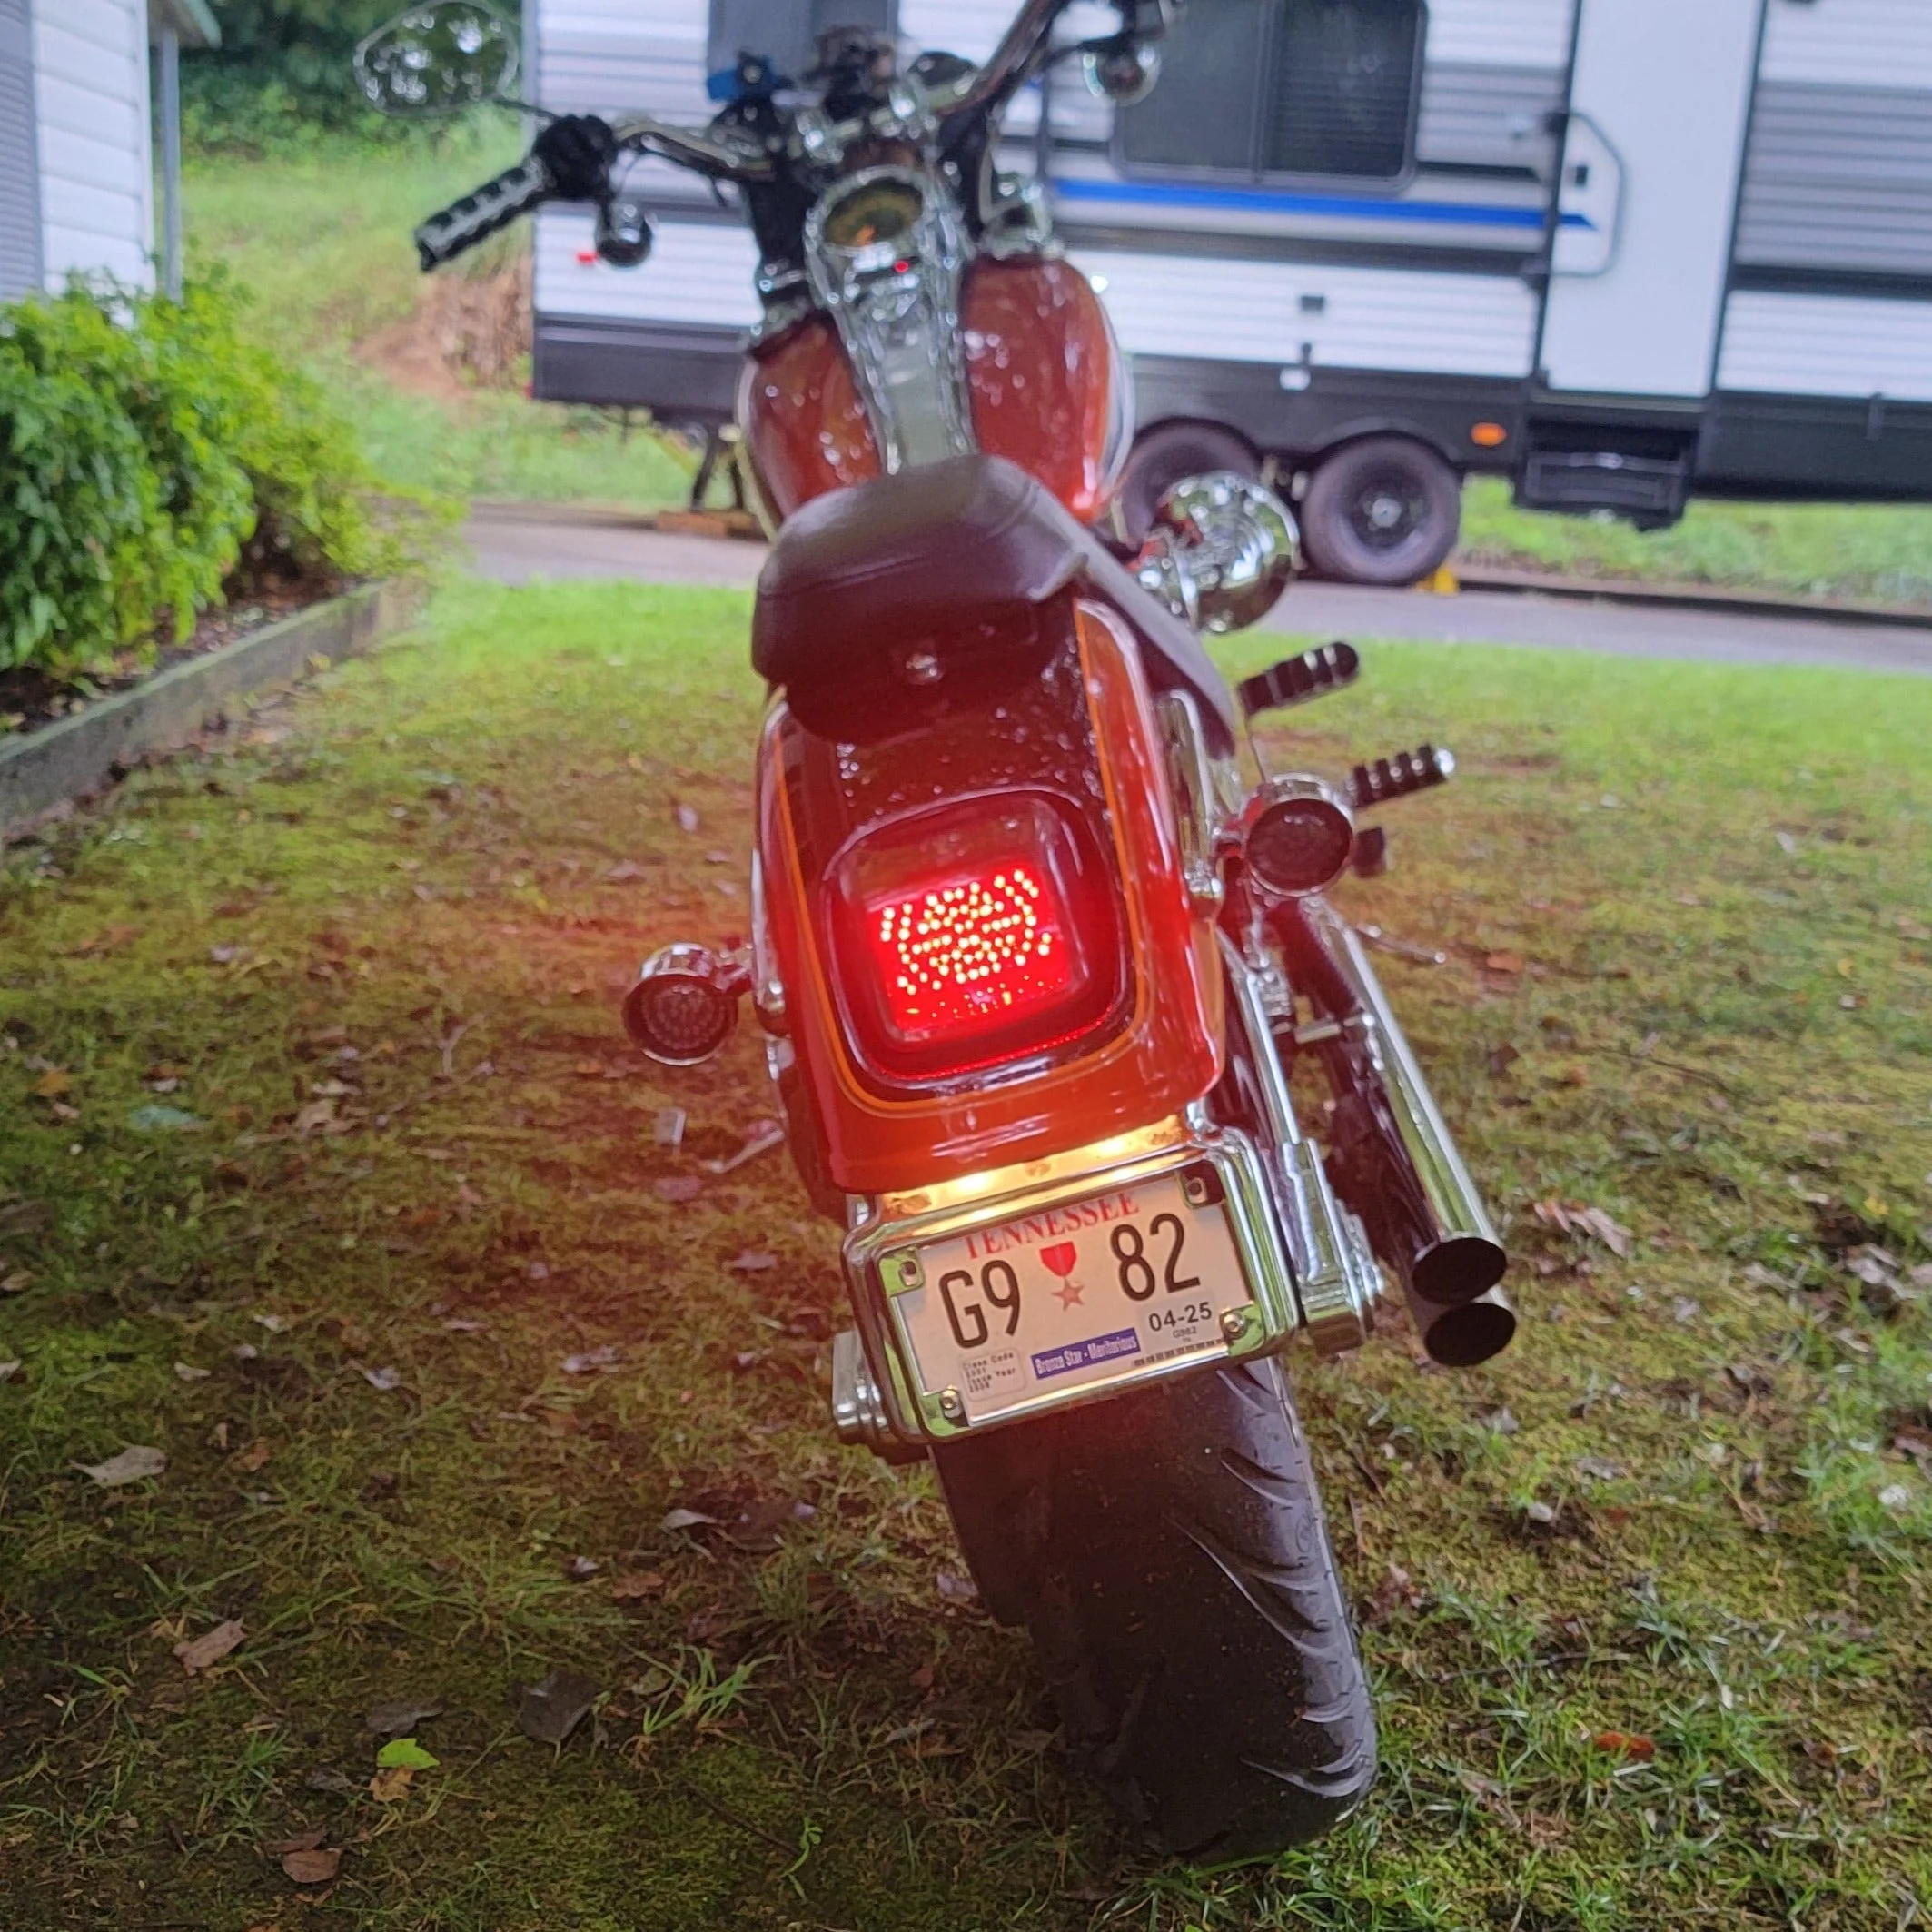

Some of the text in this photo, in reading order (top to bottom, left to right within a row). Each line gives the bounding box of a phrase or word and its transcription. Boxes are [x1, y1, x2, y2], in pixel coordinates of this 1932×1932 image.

[963, 1193, 1139, 1259] TENNESSEE
[938, 1213, 1201, 1349] G9 82
[1149, 1302, 1212, 1331] 04-25
[1063, 1350, 1083, 1367] Star
